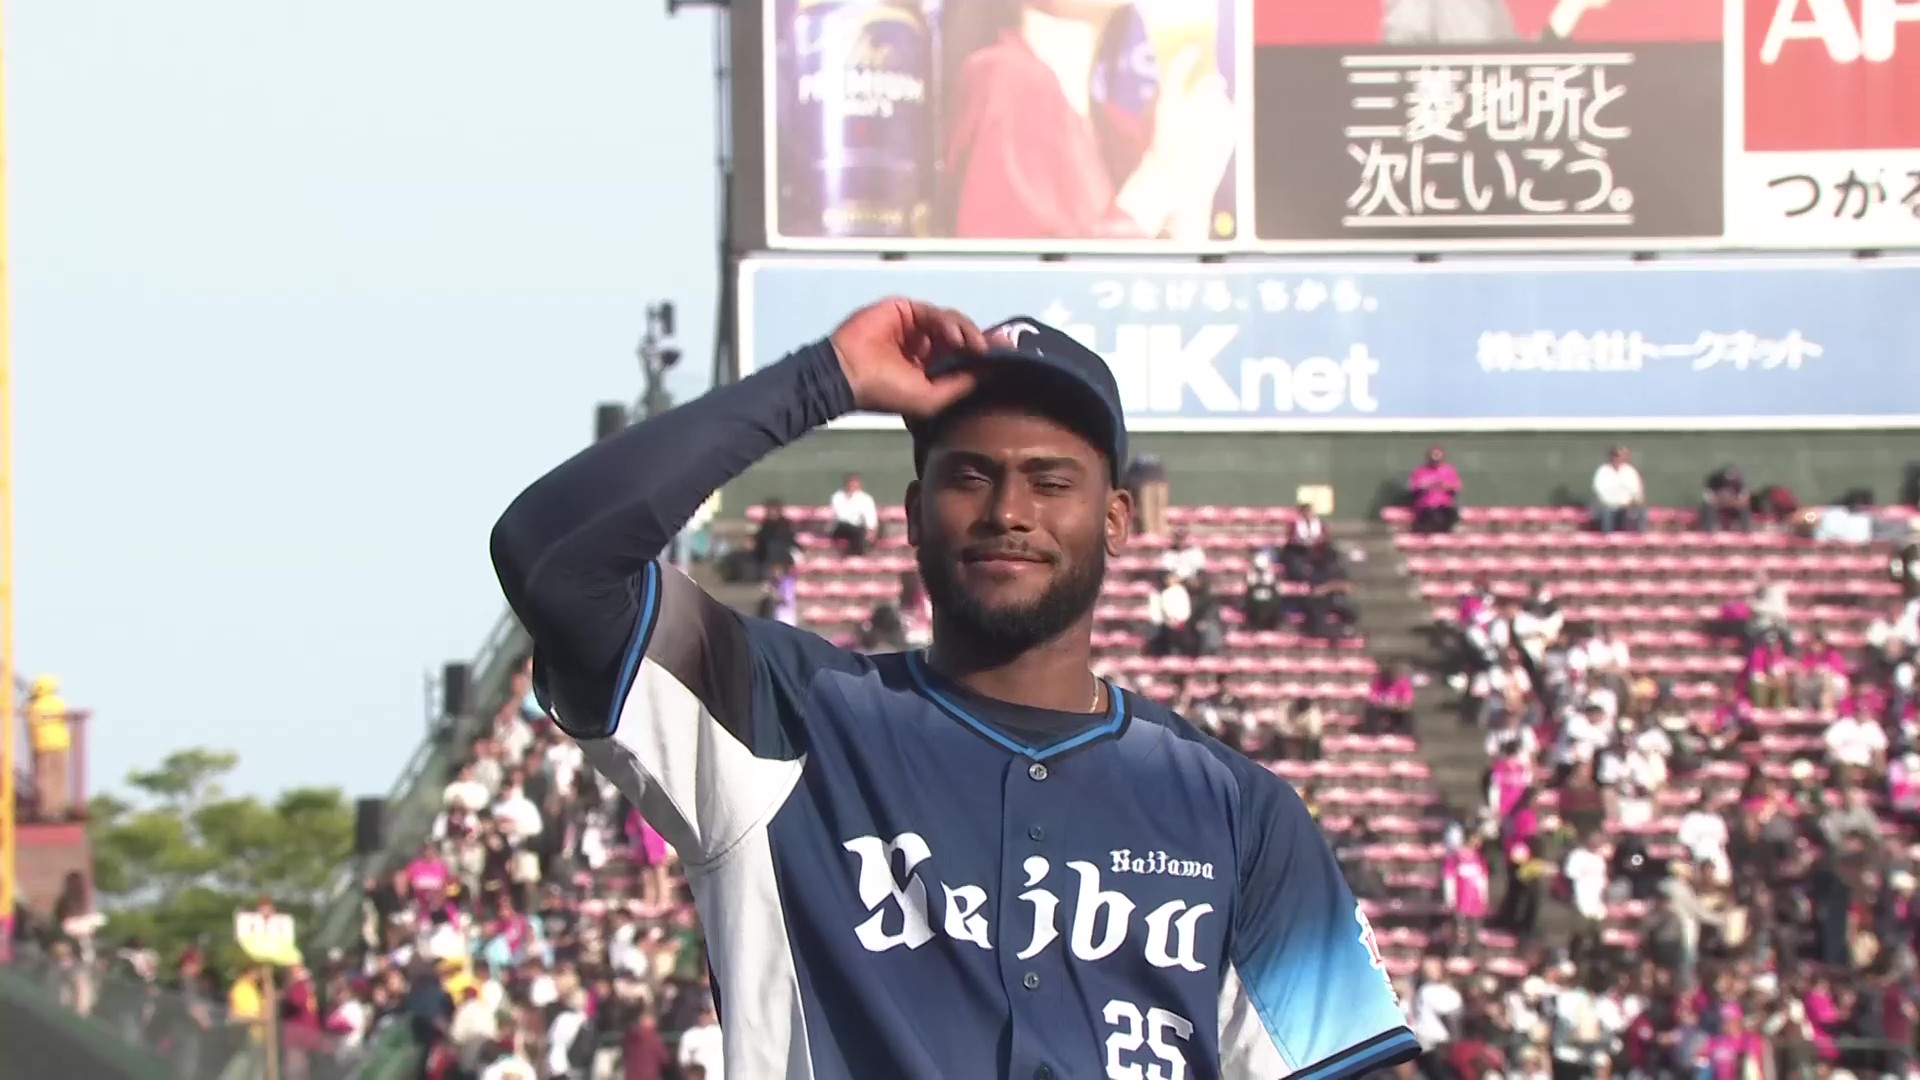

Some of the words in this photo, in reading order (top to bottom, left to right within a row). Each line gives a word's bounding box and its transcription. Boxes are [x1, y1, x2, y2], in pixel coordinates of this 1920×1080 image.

[1345, 64, 1632, 141] 三菱地所と
[1346, 139, 1634, 216] 次にいこう。
[842, 832, 1214, 972] Seibu
[1109, 848, 1215, 881] Saitama
[1102, 999, 1194, 1080] 25
